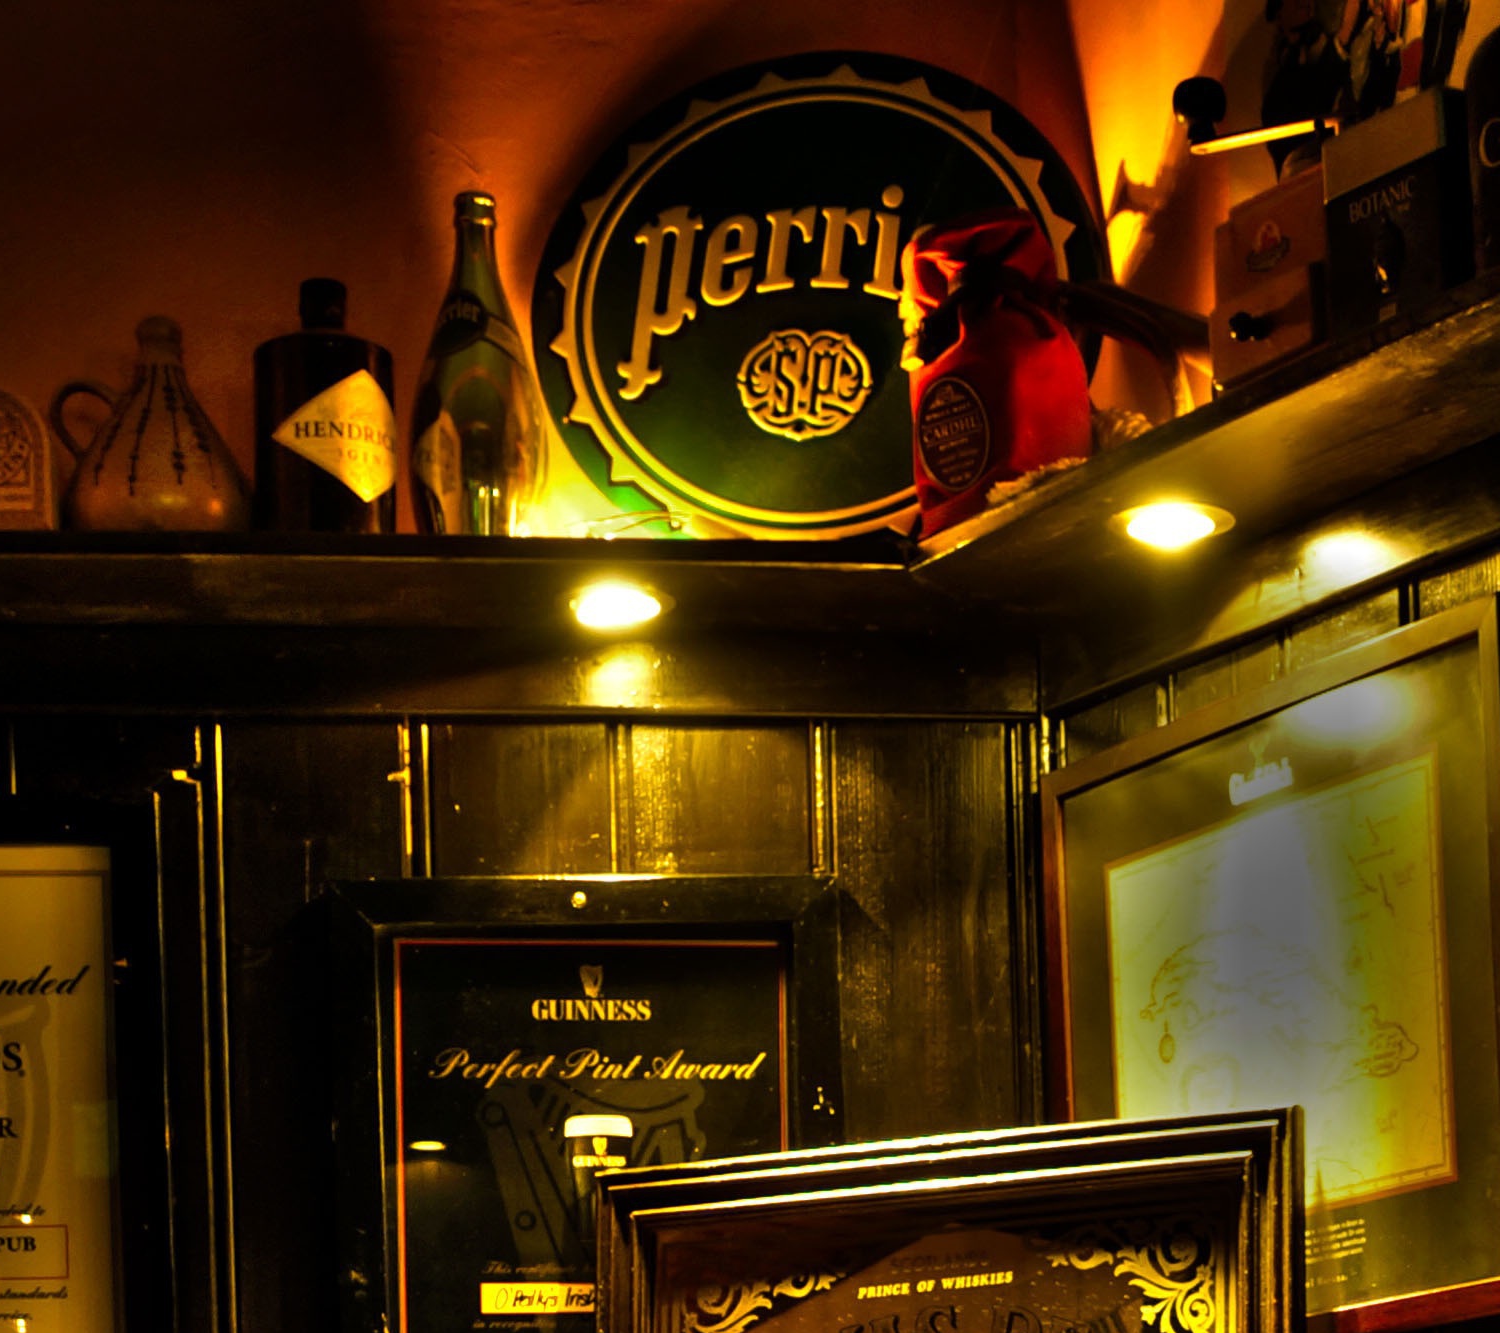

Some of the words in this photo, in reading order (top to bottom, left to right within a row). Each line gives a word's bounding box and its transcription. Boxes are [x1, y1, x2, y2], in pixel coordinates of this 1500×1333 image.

[530, 999, 652, 1022] GUINNESS
[428, 1047, 556, 1090] Perfect
[559, 1047, 642, 1080] Pint
[643, 1048, 767, 1081] Award
[856, 1281, 911, 1300] PRINCE
[916, 1278, 937, 1294] OF
[940, 1269, 1014, 1290] WHISKIES
